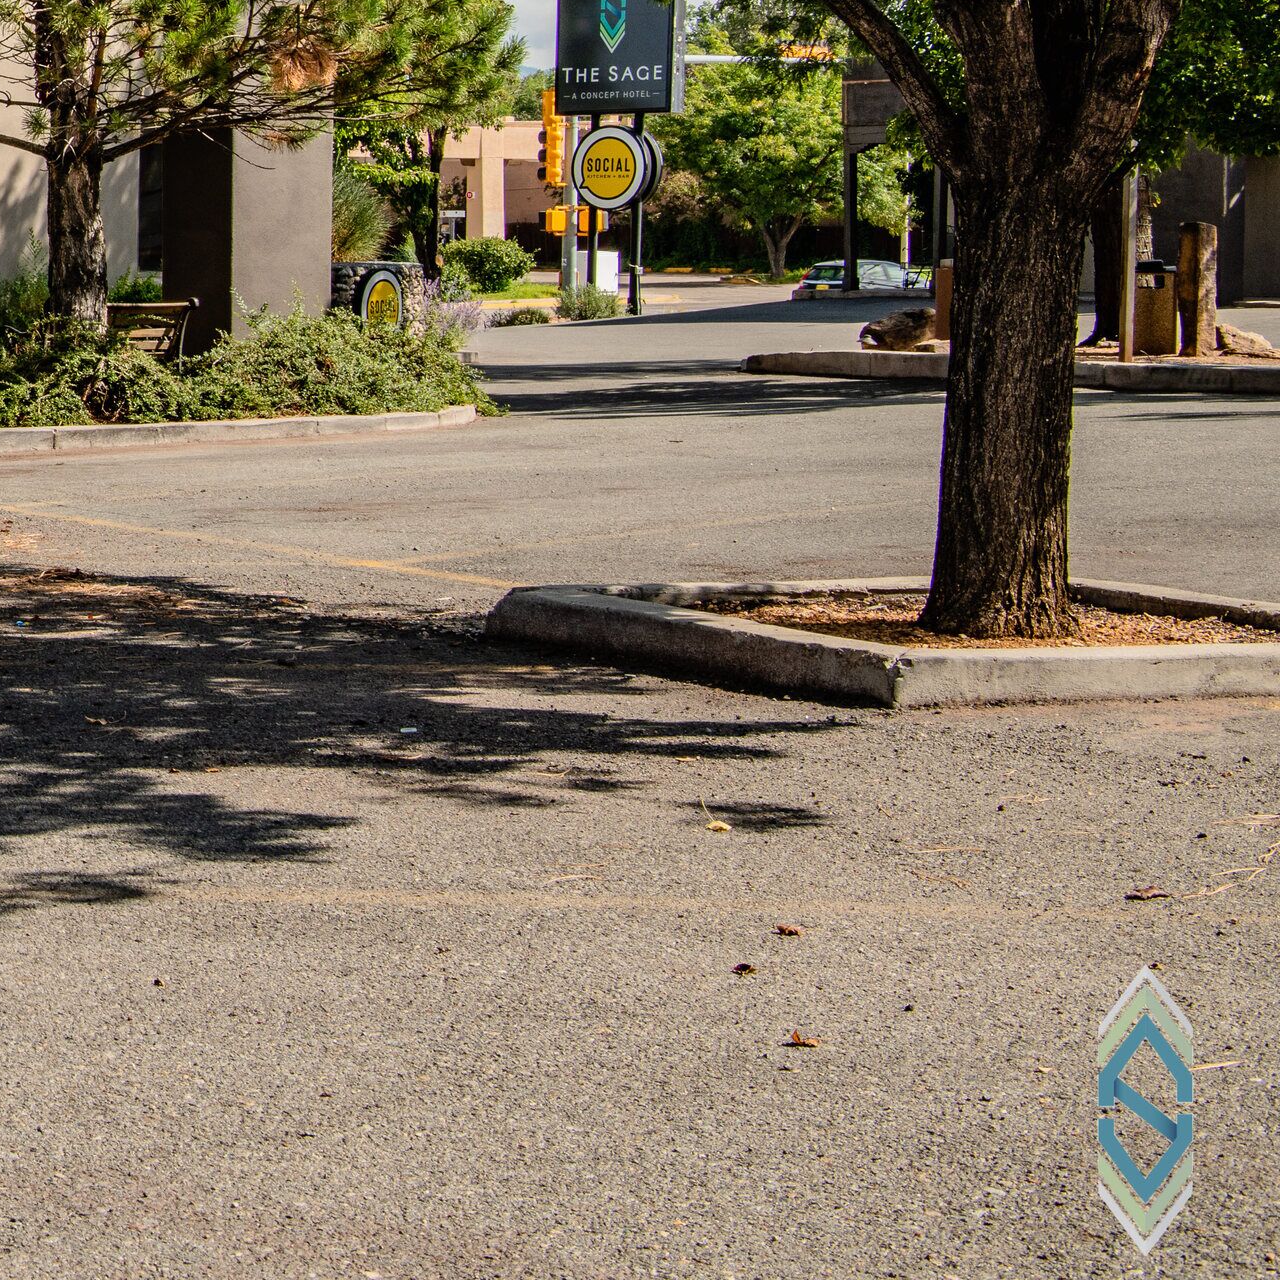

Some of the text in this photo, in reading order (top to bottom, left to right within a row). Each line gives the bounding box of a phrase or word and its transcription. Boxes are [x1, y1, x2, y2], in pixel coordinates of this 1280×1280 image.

[562, 65, 662, 83] THE SAGE
[572, 90, 651, 100] A CONCEPT HOTEL
[587, 158, 630, 172] SOCIAL
